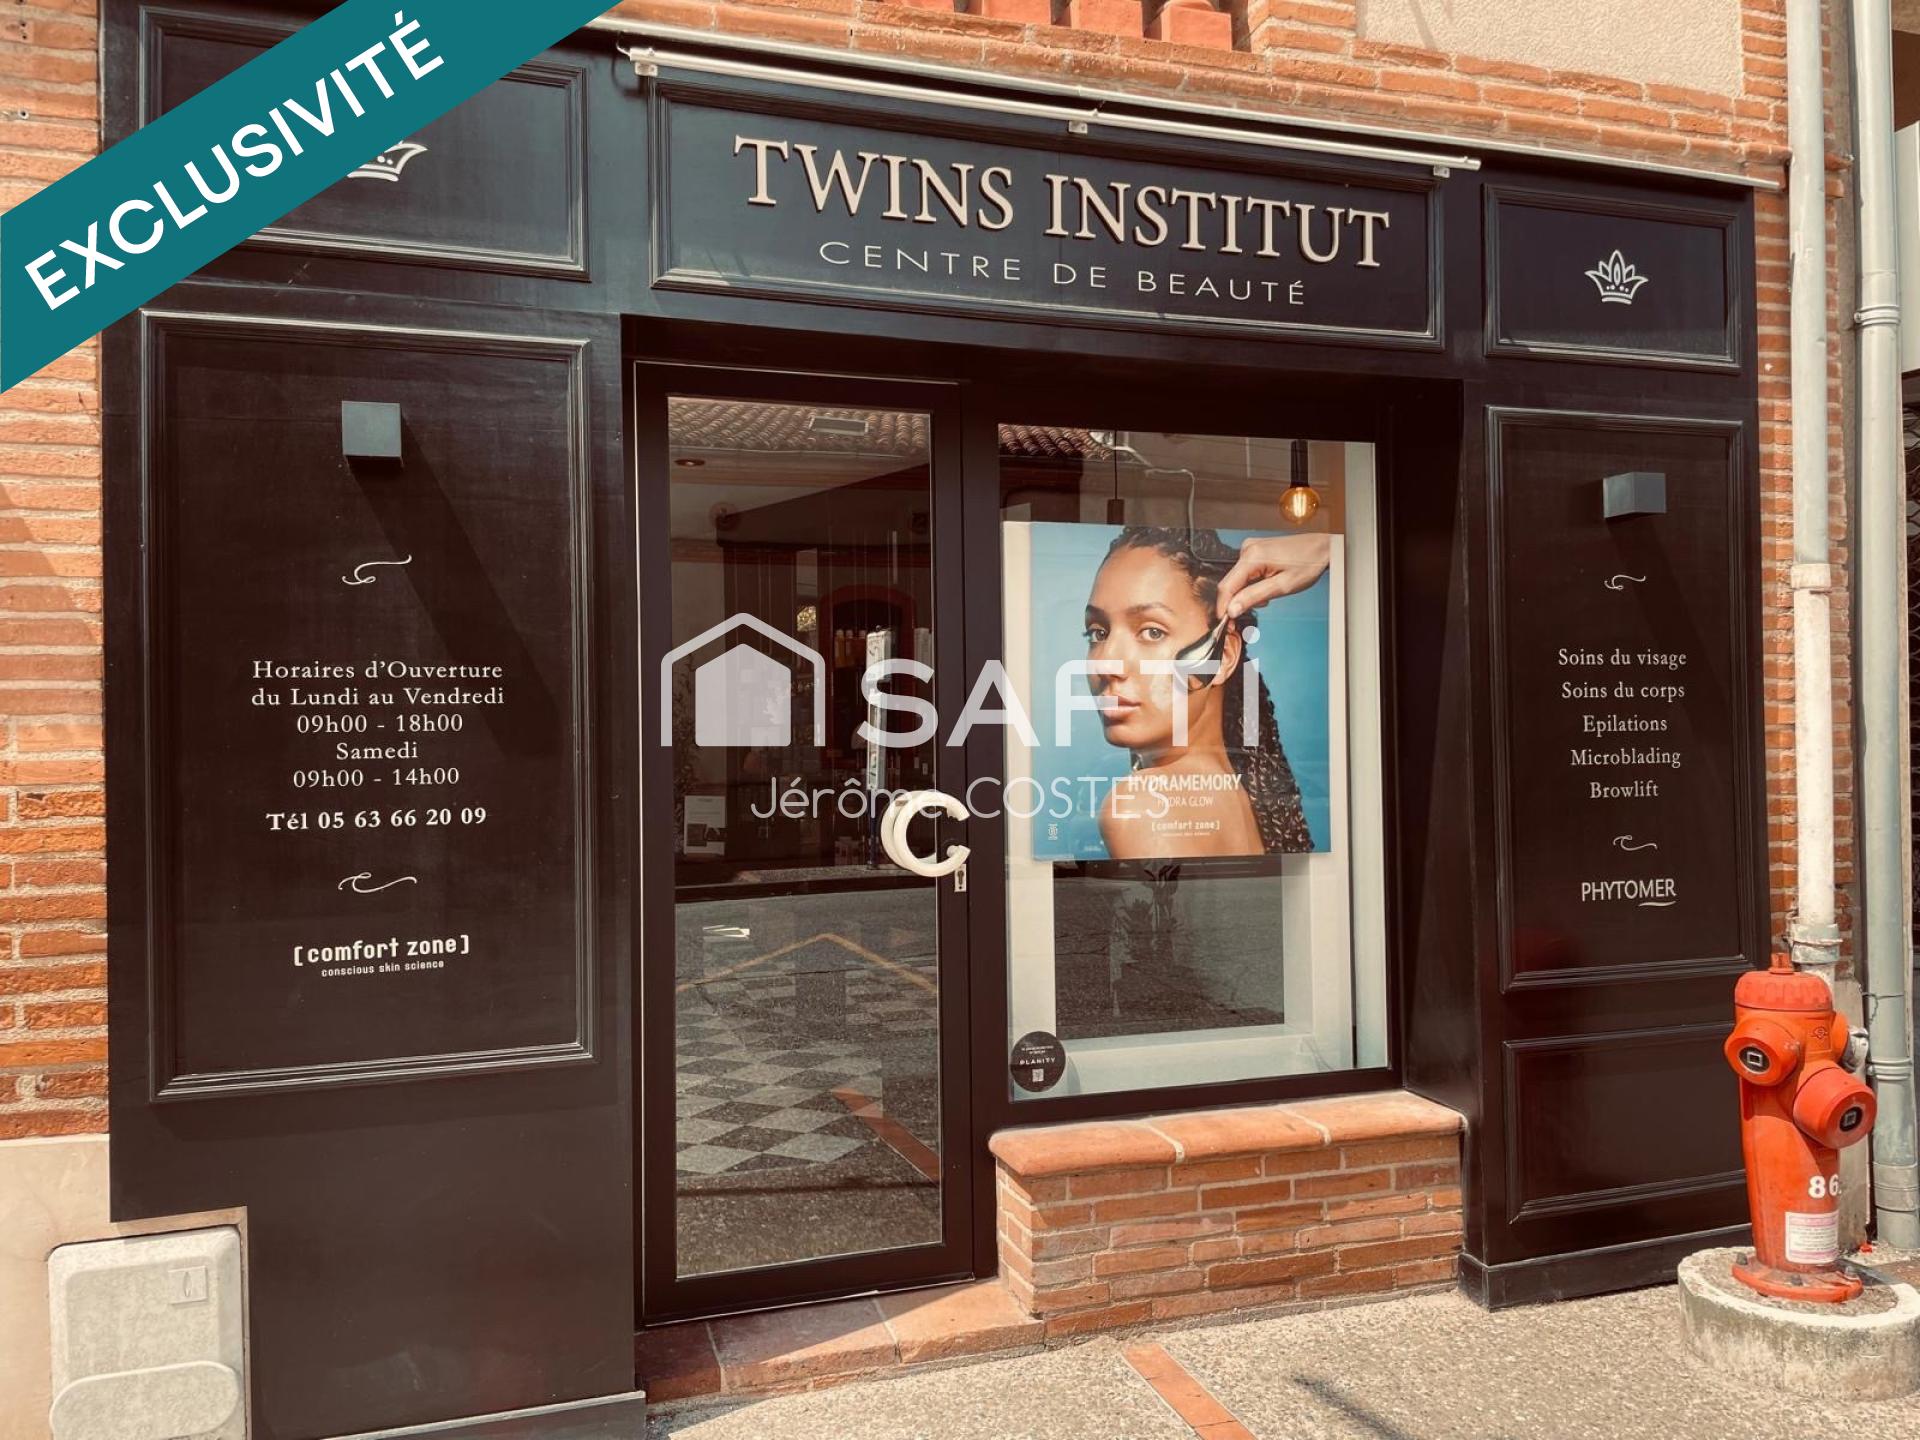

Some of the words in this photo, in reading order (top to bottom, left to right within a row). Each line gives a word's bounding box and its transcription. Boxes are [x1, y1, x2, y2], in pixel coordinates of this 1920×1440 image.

[733, 134, 1014, 230] TWINS
[1044, 173, 1391, 268] INSTITUT
[819, 241, 1021, 282] CENTRE
[1053, 263, 1107, 289] DE
[1137, 270, 1305, 305] BEAUTÉ
[252, 660, 355, 679] Horaires
[364, 660, 503, 679] d'Ouverture
[1558, 648, 1604, 666] Soins
[1610, 648, 1631, 666] du
[1636, 648, 1687, 671] visage
[251, 687, 281, 707] du
[290, 687, 360, 706] Lundi
[368, 693, 395, 705] au
[403, 686, 506, 705] Vendredi
[1561, 681, 1608, 699] Soins
[1613, 681, 1635, 698] du
[1640, 686, 1685, 703] corps
[296, 714, 368, 734] 09h00
[396, 713, 463, 732] 18h00
[1583, 714, 1668, 738] Epilations
[336, 741, 419, 761] Samedi
[1570, 747, 1681, 769] Microblading
[293, 769, 365, 788] 09h00
[393, 767, 460, 786] 14h00
[1128, 774, 1241, 791] HYDRAMEMORY
[1589, 780, 1660, 799] Browlift
[1188, 796, 1215, 807] GLOW
[265, 812, 309, 831] Tél
[317, 811, 345, 829] 05
[354, 810, 382, 828] 63
[390, 809, 418, 827] 66
[426, 808, 452, 826] 20
[460, 807, 488, 825] 09
[1581, 878, 1677, 902] PHYTOMER
[293, 937, 400, 967] [comfort
[406, 934, 470, 956] zone]
[321, 964, 375, 978] conscious
[378, 962, 401, 974] skin
[404, 959, 445, 972] science
[1808, 1173, 1842, 1199] 86
